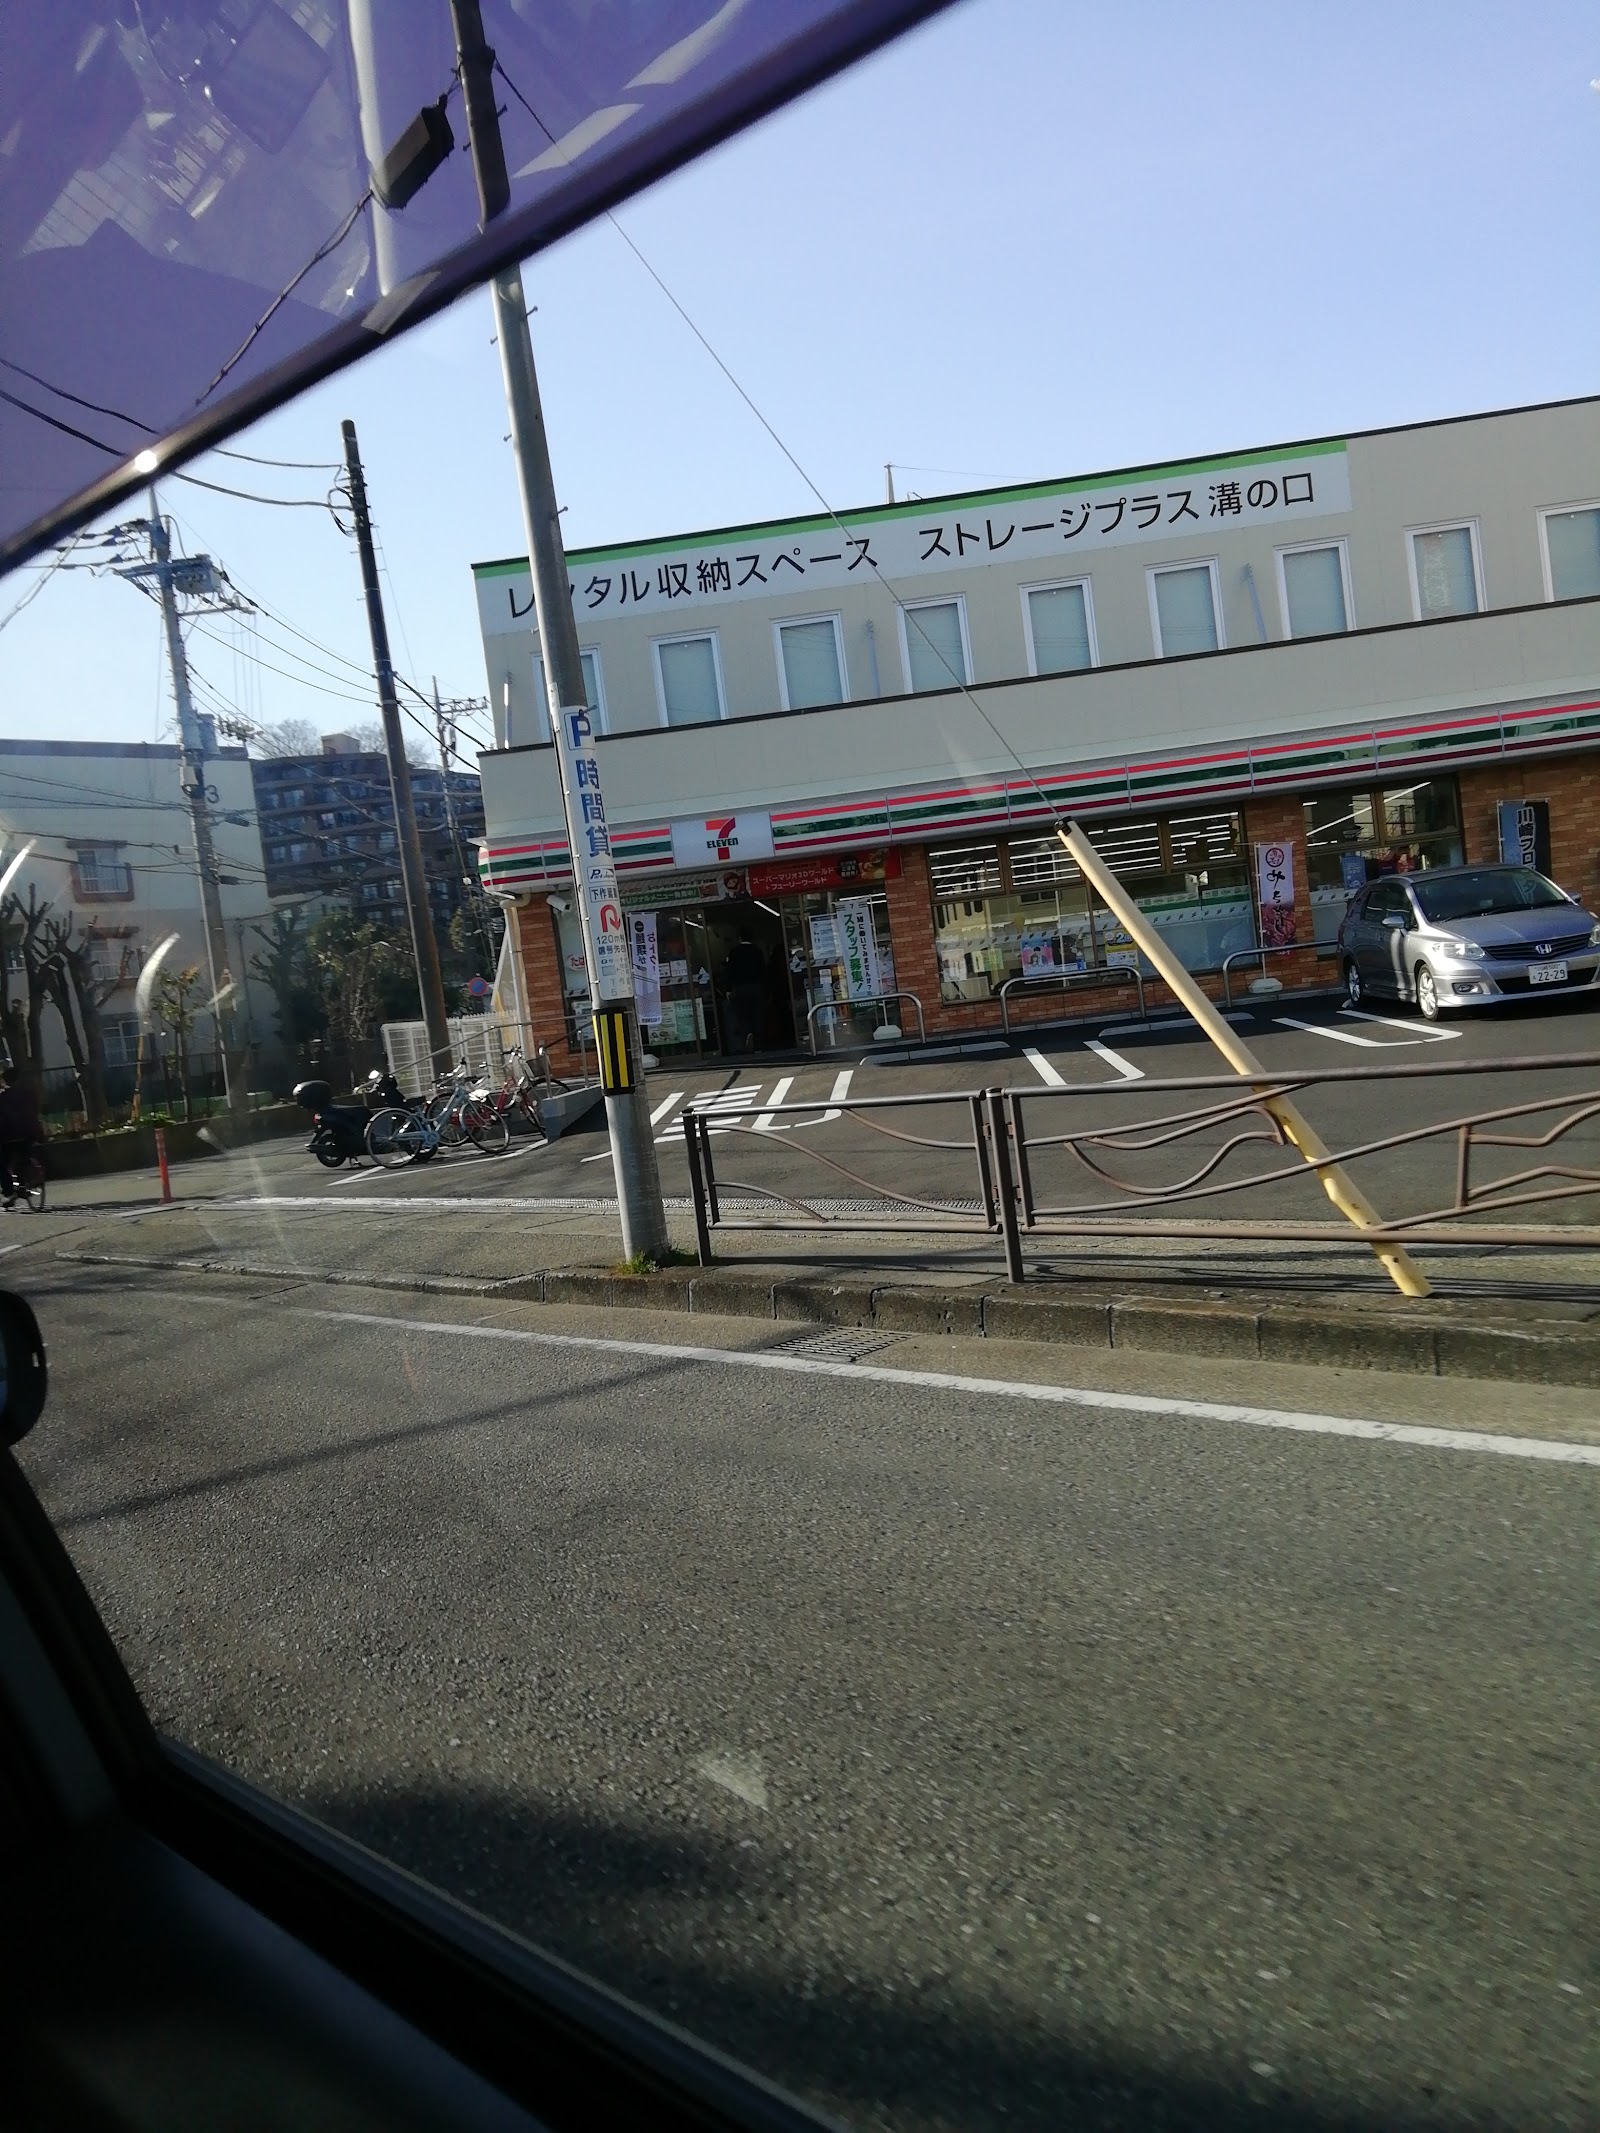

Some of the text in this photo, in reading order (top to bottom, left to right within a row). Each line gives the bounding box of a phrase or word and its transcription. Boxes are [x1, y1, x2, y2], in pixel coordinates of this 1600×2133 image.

[508, 538, 878, 619] レタル収納スペース
[571, 713, 591, 747] P
[576, 758, 611, 857] 時間貸
[1537, 969, 1566, 982] 22-29
